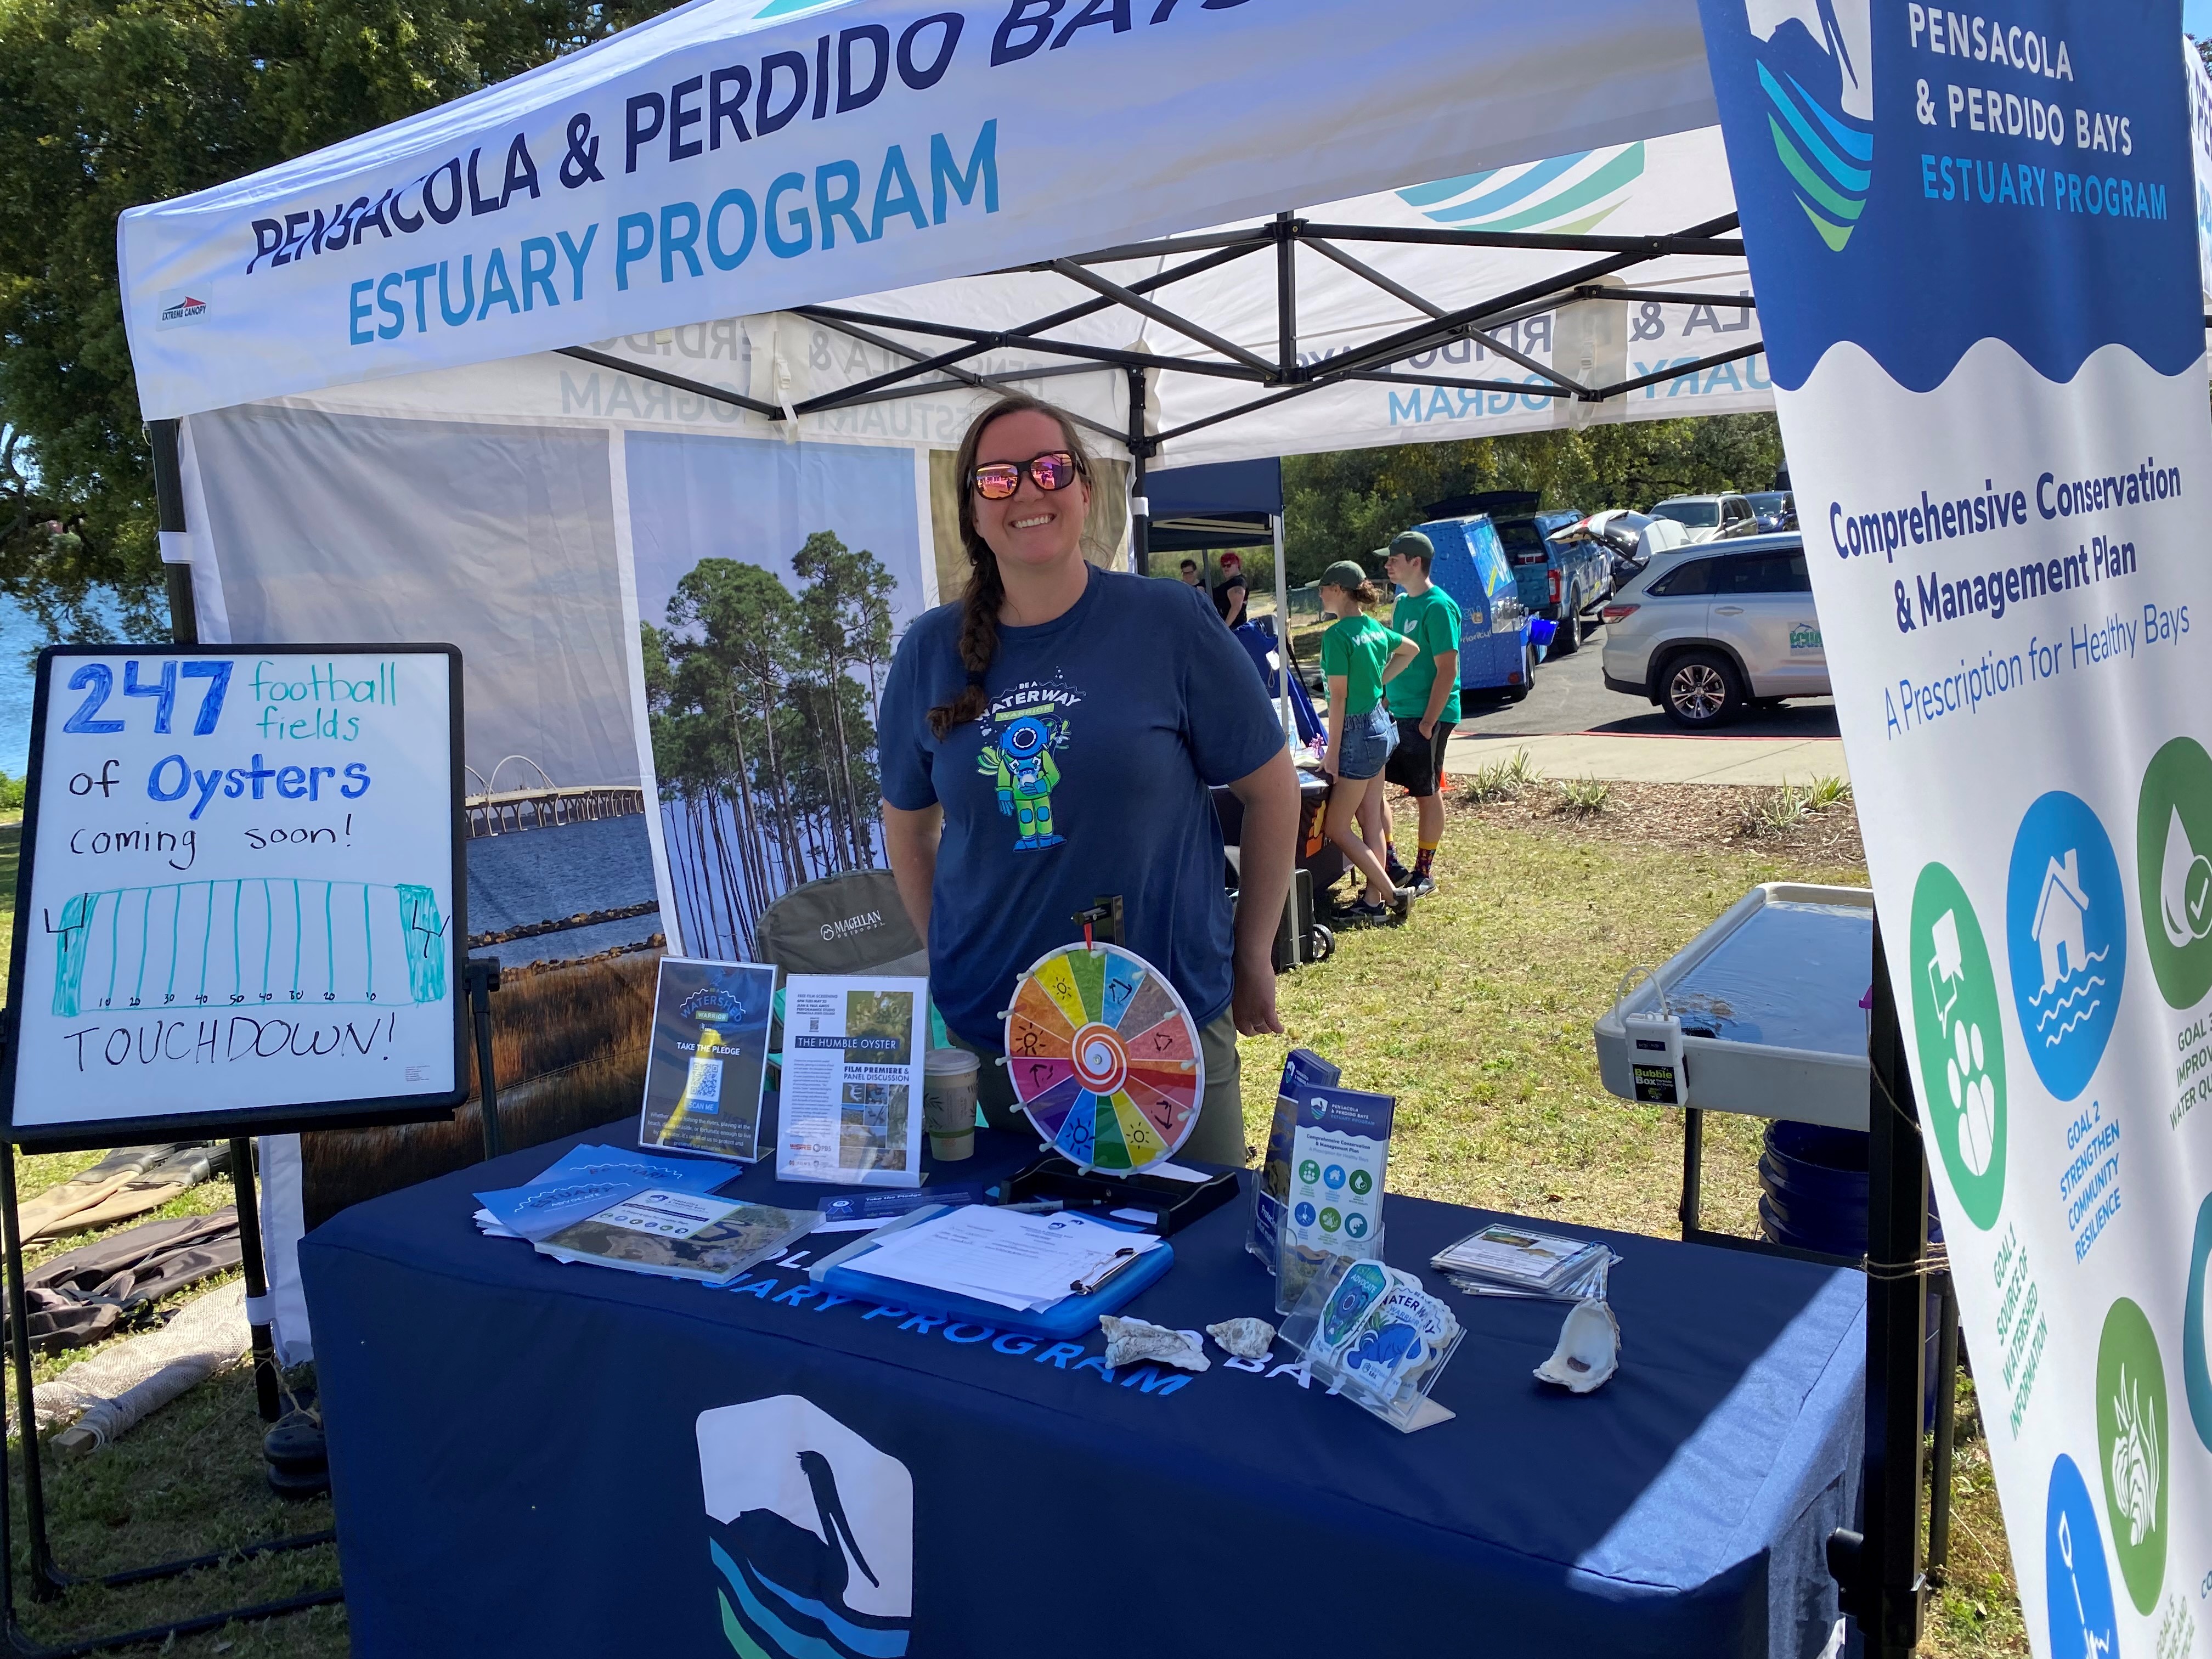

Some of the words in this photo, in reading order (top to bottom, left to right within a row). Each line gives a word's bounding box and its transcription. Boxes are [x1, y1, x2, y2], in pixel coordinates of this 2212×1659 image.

[1909, 2, 2074, 82] PENSACOLA
[1916, 78, 1937, 125] &
[1949, 84, 2064, 146] PERDIDO
[2076, 110, 2132, 156] BAYS
[246, 132, 540, 275] PENSACOLA
[559, 112, 605, 189] &
[626, 12, 964, 173] PERDIDO
[1922, 154, 2046, 208] ESTUARY
[2055, 171, 2168, 221] PROGRAM
[349, 223, 599, 345] ESTUARY
[616, 118, 998, 291] PROGRAM
[162, 309, 183, 321] EXTREME
[184, 303, 207, 317] CANOPY
[1830, 478, 2027, 563] Comprehensive
[2036, 456, 2182, 520] Conservation
[1894, 579, 1915, 633] &
[1916, 544, 2090, 628] Management
[2093, 535, 2137, 582] Plan
[1019, 681, 1030, 690] BE
[1883, 687, 1902, 740] A
[1899, 651, 2023, 731] Prescription
[2028, 636, 2062, 681] for
[2071, 612, 2138, 670] Healthy
[2144, 603, 2190, 646] Bays
[63, 660, 234, 736] 247
[248, 662, 396, 706] football
[1000, 704, 1053, 720] WARRIOR
[256, 708, 360, 742] fields
[69, 759, 120, 797] of
[146, 753, 371, 821] Oysters
[71, 822, 196, 870] coming
[244, 813, 352, 850] soon!
[833, 910, 882, 934] MAGELLAN
[99, 997, 111, 1007] 10
[129, 997, 141, 1006] 20
[164, 994, 175, 1005] 30
[195, 994, 208, 1004] 40
[229, 994, 245, 1005] 50
[259, 992, 273, 1003] 40
[323, 991, 336, 1001] 20
[680, 995, 742, 1022] WATERSHED
[64, 1012, 396, 1071] TOUCHDOWN!
[676, 1042, 696, 1051] TAKE
[697, 1044, 711, 1052] THE
[712, 1046, 741, 1056] PLEDGE
[798, 1038, 816, 1047] THE
[819, 1039, 857, 1048] HUMBLE
[861, 1039, 896, 1049] OYSTER
[2178, 1019, 2207, 1052] GOAL
[867, 1074, 910, 1082] DISCUSSION
[1634, 1068, 1673, 1079] Bubble
[1635, 1076, 1656, 1085] Box
[689, 1102, 704, 1110] SCAN
[1331, 1104, 1359, 1113] PENSACOLA
[1352, 1117, 1375, 1125] PROGRAM
[2170, 1086, 2197, 1131] WATER
[720, 1121, 737, 1130] playing
[1306, 1133, 1340, 1144] Comprehensive
[1340, 1140, 1370, 1150] Conservation
[2067, 1110, 2092, 1150] GOAL
[2093, 1101, 2100, 1123] 2
[1319, 1142, 1348, 1152] Management
[2061, 1119, 2120, 1202] STRENGTHEN
[530, 1186, 614, 1207] ESTUARY
[551, 1193, 601, 1206] ADVOCATE
[2068, 1153, 2119, 1231] COMMUNITY
[2075, 1187, 2121, 1266] RESILIENCE
[1994, 1234, 2012, 1288] GOAL
[2010, 1221, 2016, 1249] 1
[1351, 1273, 1378, 1294] ADVOCATE
[1997, 1266, 2022, 1346] SOURCE
[2019, 1245, 2028, 1282] OF
[2002, 1281, 2038, 1392] WATERSHED
[2010, 1311, 2047, 1441] INFORMATION
